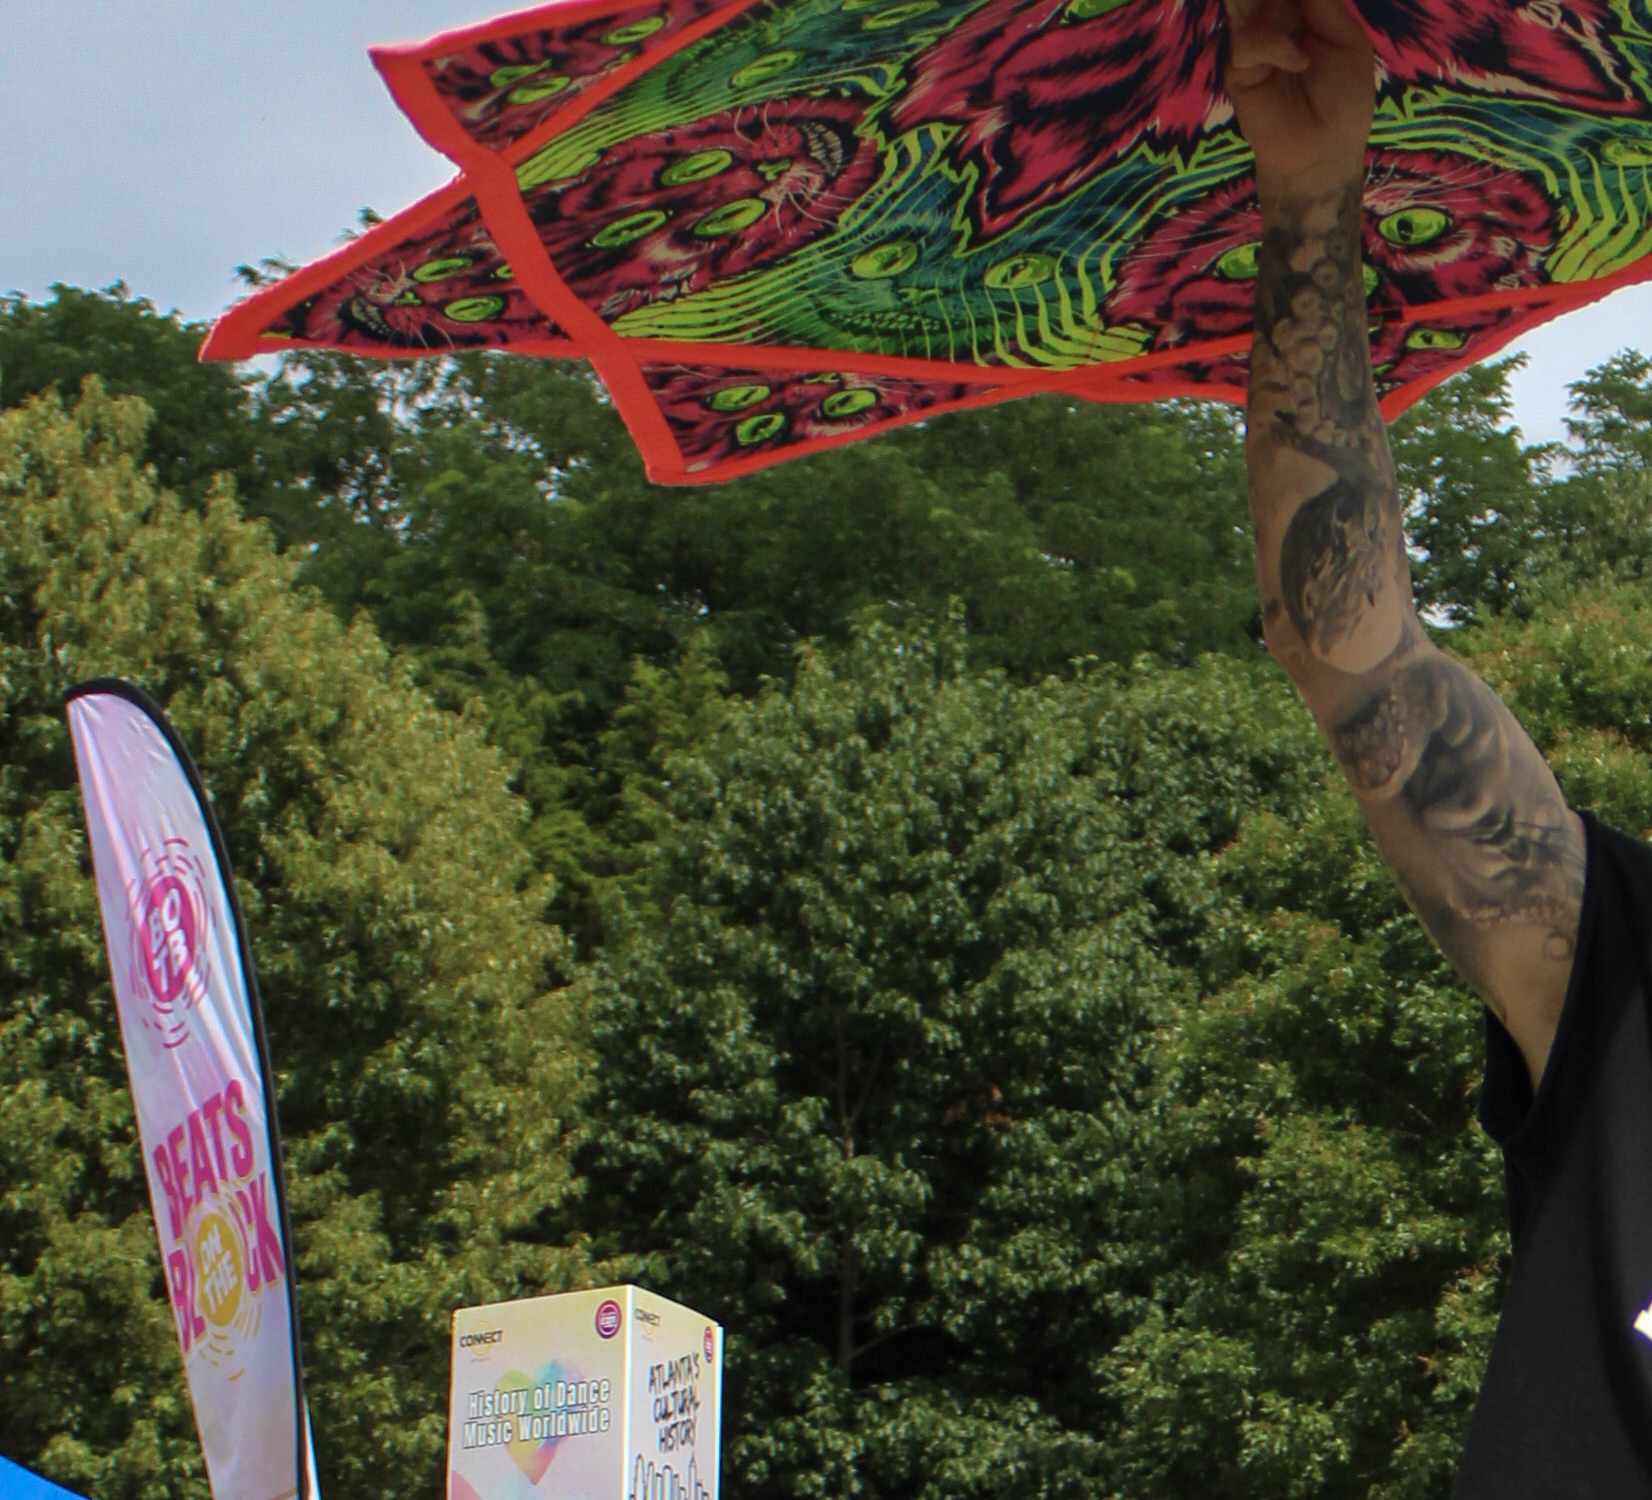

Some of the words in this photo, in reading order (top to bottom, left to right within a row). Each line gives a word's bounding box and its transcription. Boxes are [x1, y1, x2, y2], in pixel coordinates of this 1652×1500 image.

[153, 1078, 254, 1246] BEATS
[200, 1221, 224, 1276] ON
[203, 1250, 239, 1315] THE
[648, 1351, 700, 1394] ATLANTA'S
[468, 1389, 529, 1420] History
[533, 1382, 552, 1411] of
[556, 1378, 611, 1408] Dance
[652, 1385, 701, 1423] CULTURAL
[462, 1415, 514, 1450] Music
[518, 1404, 611, 1443] Worldwide
[658, 1416, 698, 1453] HISTORY
